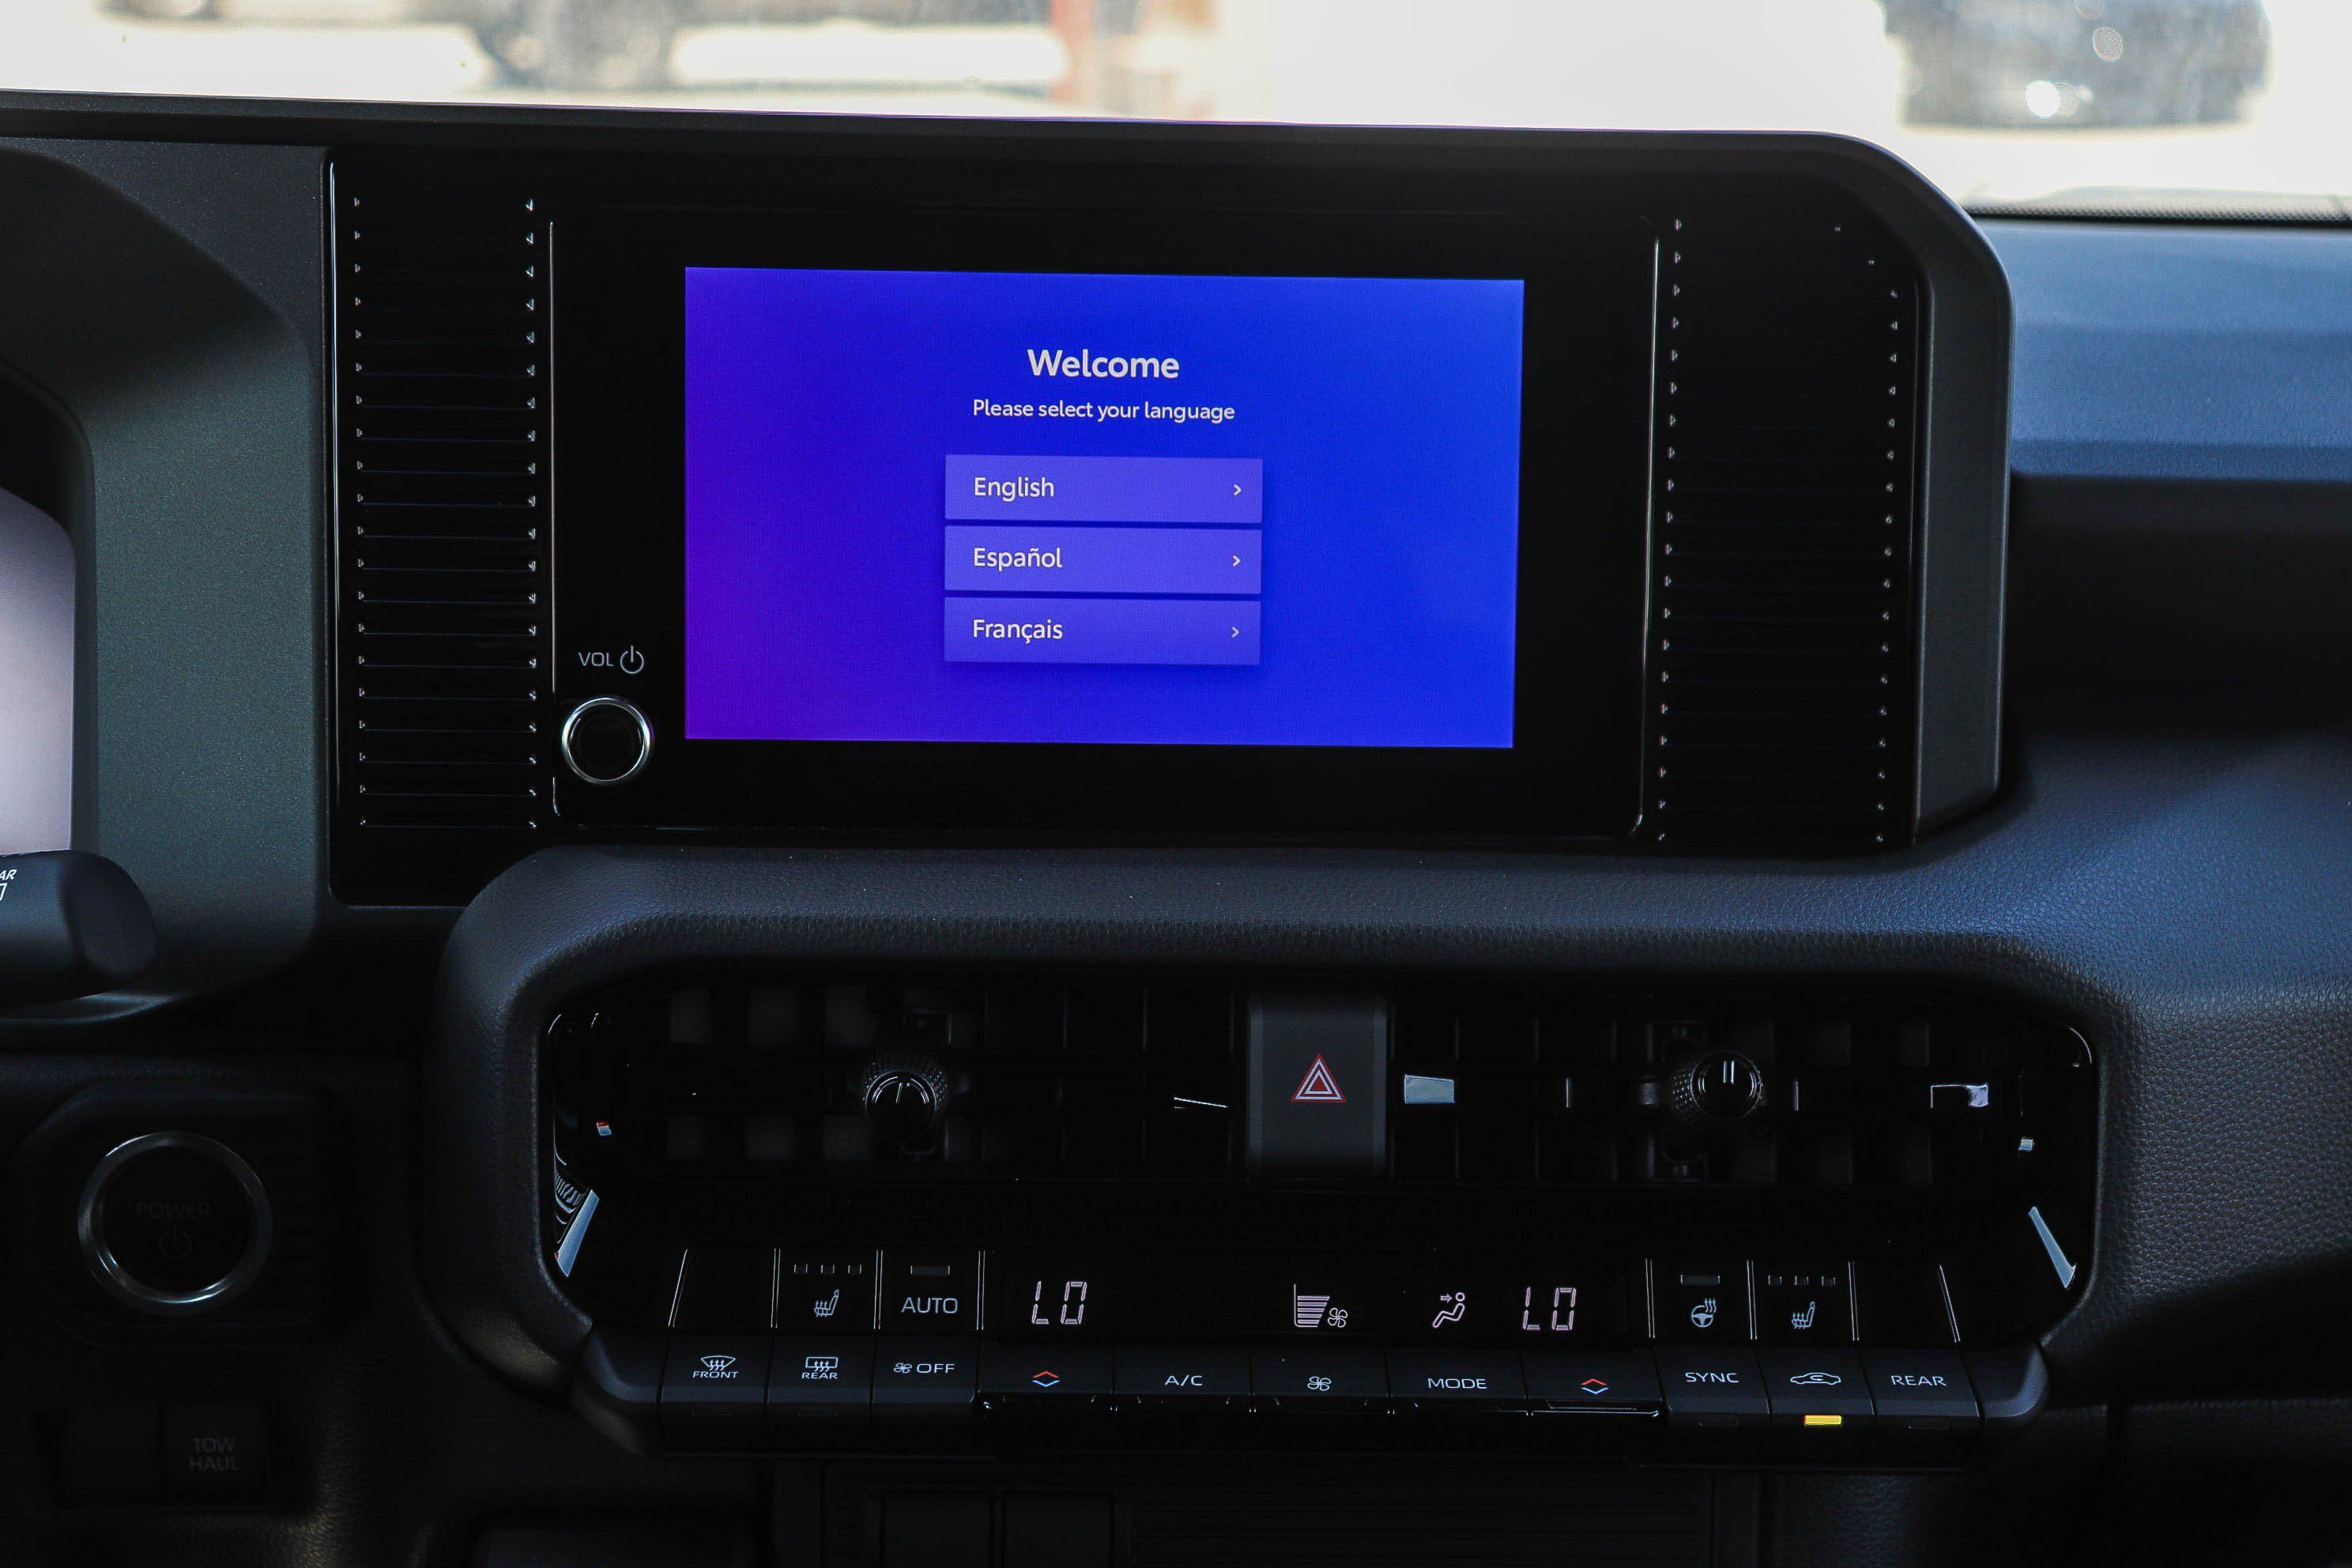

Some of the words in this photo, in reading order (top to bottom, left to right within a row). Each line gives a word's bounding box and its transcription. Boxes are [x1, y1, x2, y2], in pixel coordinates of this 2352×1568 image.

[1027, 349, 1181, 379] Welcome
[973, 398, 1035, 417] Please
[1038, 400, 1093, 418] select
[1097, 404, 1140, 422] your
[1144, 401, 1235, 424] language
[973, 476, 1055, 502] English
[973, 547, 1063, 571] Español
[972, 619, 1063, 644] Français
[578, 651, 614, 667] VOL
[136, 1201, 211, 1219] POWER
[900, 1297, 959, 1314] AUTO
[692, 1370, 739, 1379] FRONT
[801, 1371, 838, 1380] REAR
[916, 1363, 956, 1374] OFF
[1164, 1374, 1204, 1387] A/C
[1427, 1378, 1487, 1390] MODE
[1684, 1372, 1740, 1384] SYNC
[1890, 1375, 1947, 1388] REAR
[192, 1437, 236, 1454] TOW
[189, 1456, 239, 1472] HAUL
